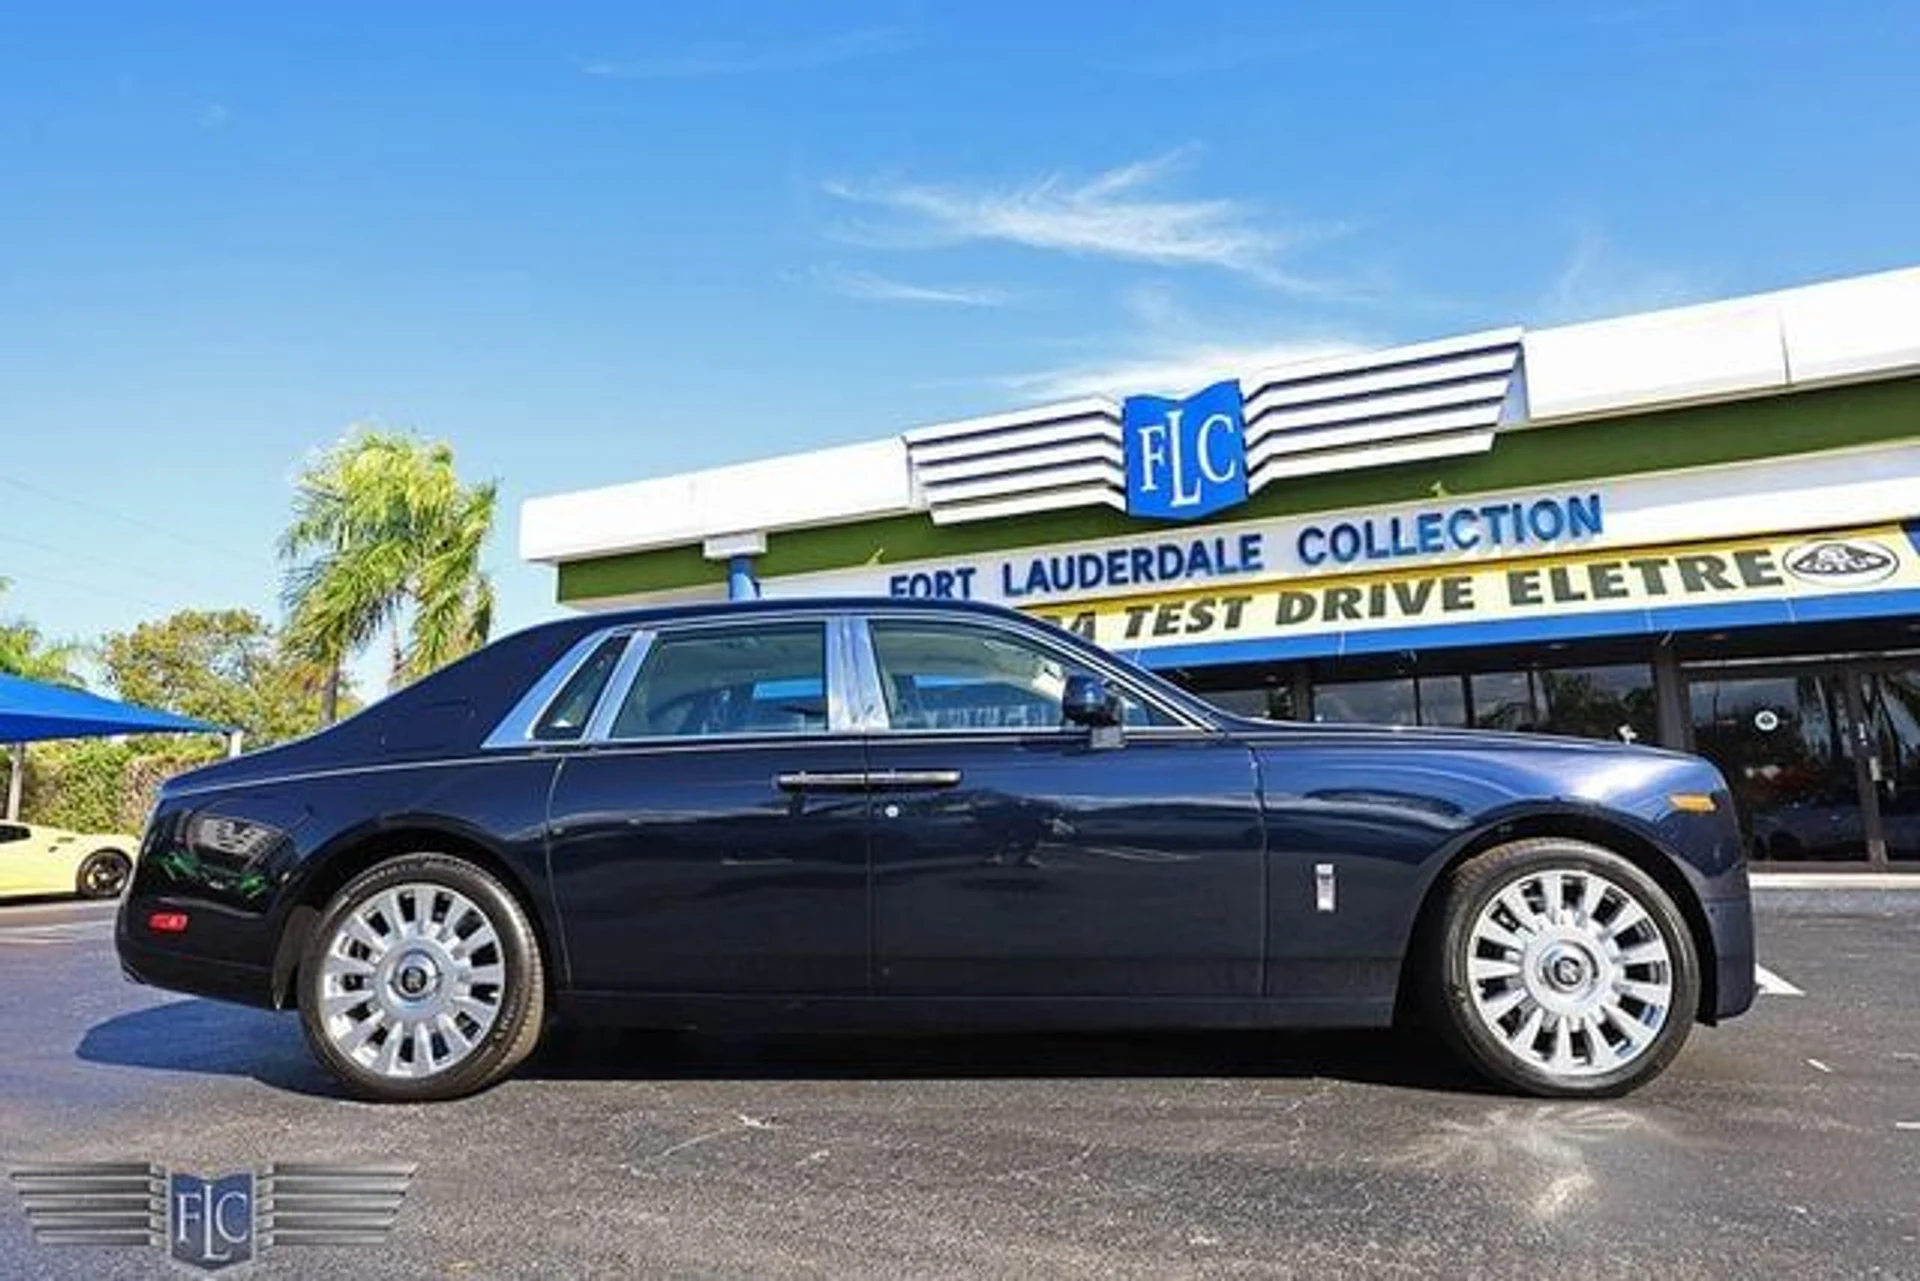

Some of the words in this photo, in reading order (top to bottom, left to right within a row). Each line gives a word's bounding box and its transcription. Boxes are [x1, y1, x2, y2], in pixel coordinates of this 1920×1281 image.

[1138, 410, 1236, 507] FLC
[890, 567, 977, 599] FORT
[1003, 534, 1262, 597] LAUDERDALE
[1297, 494, 1604, 566] COLLECTION
[1125, 596, 1252, 638] TEST
[1275, 576, 1475, 625] DRIVE
[1507, 548, 1784, 607] ELETRE
